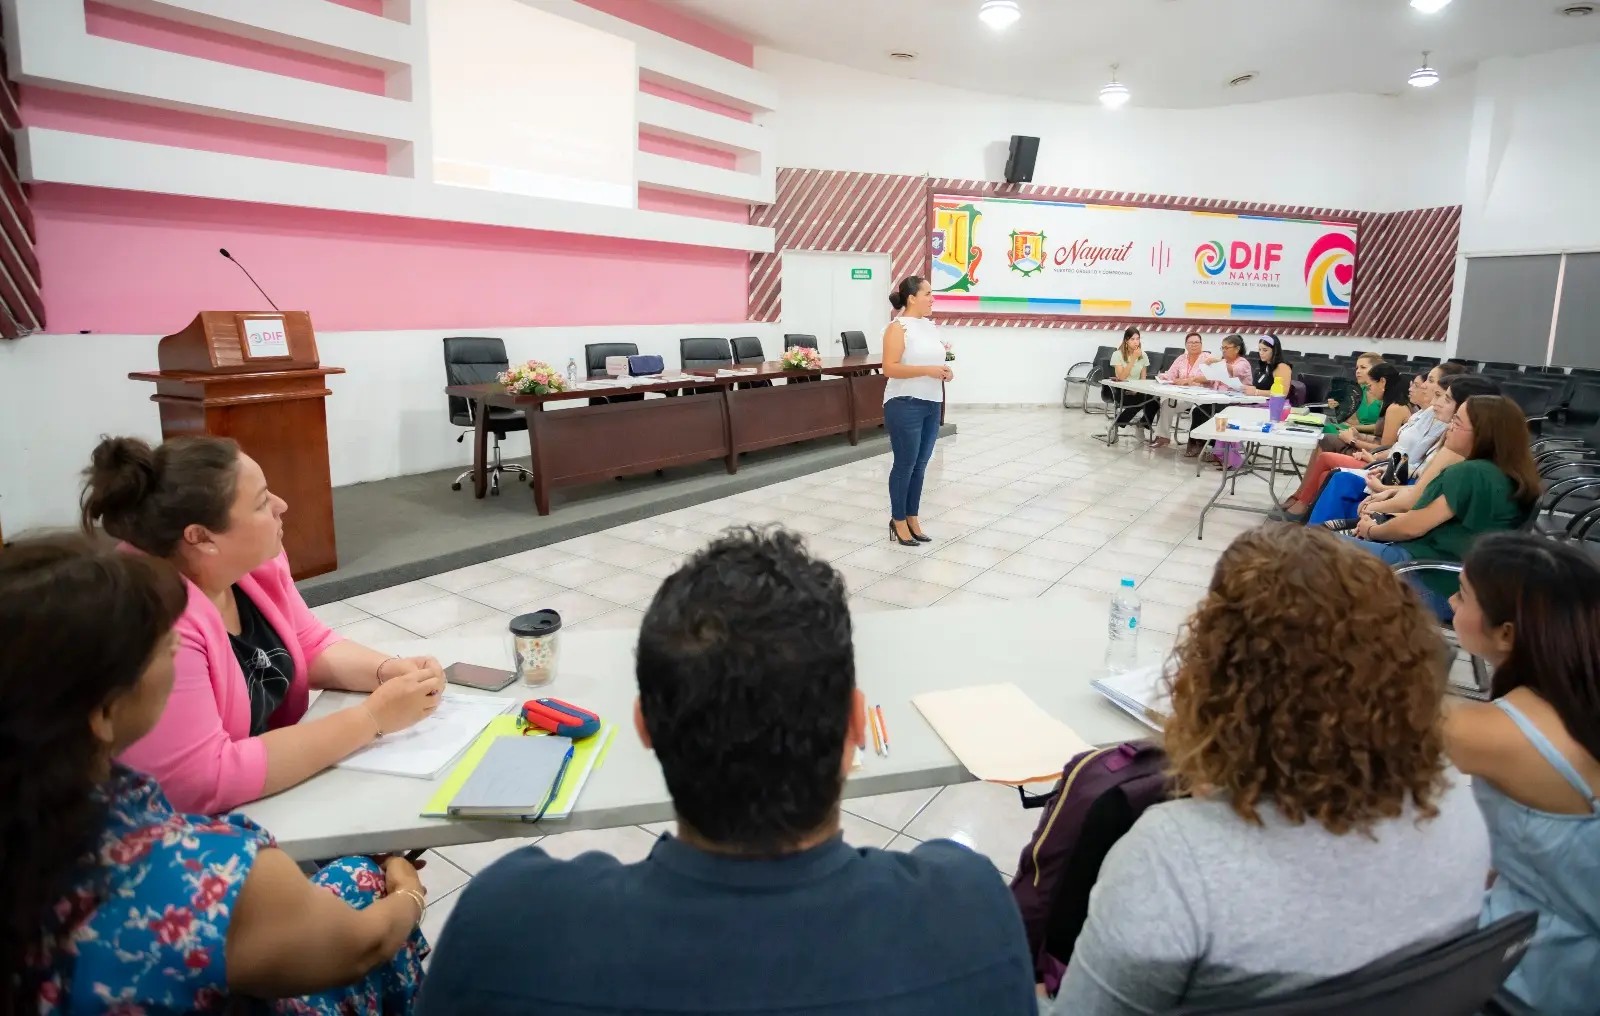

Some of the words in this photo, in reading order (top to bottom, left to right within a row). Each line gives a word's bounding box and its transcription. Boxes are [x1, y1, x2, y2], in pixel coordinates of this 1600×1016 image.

[1054, 239, 1133, 267] Nayarit
[1230, 241, 1283, 271] DIF
[1229, 271, 1281, 282] NAYARIT
[262, 331, 283, 341] DIF
